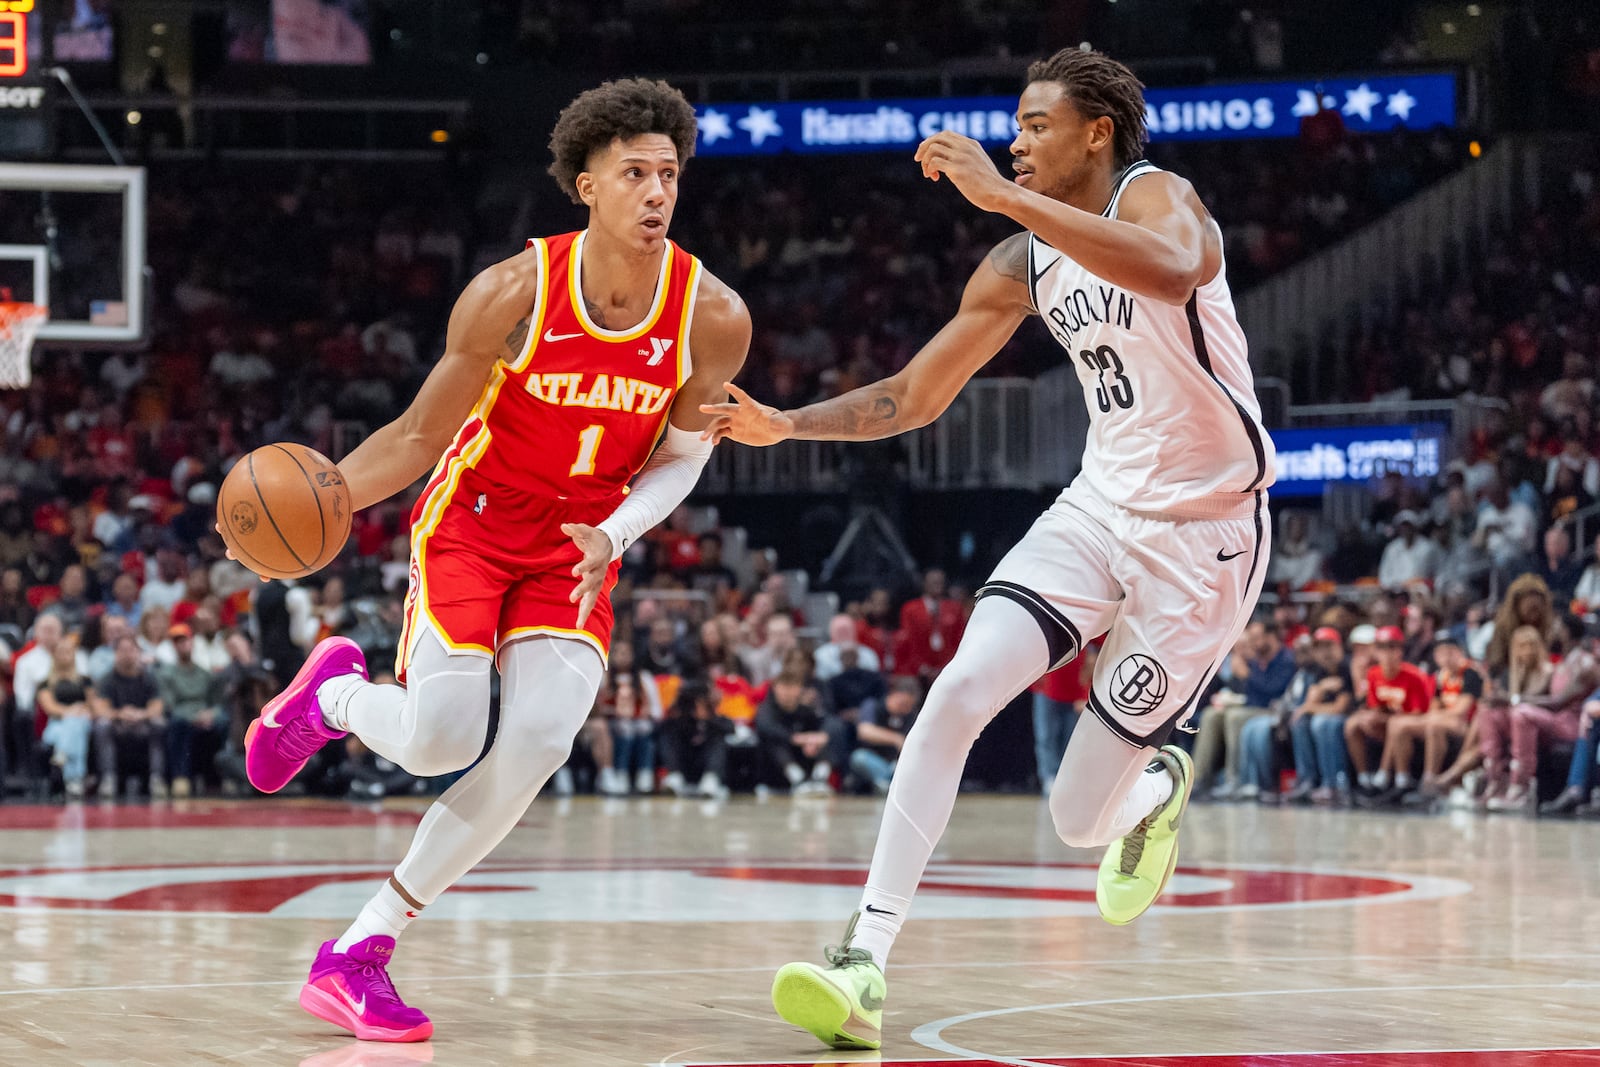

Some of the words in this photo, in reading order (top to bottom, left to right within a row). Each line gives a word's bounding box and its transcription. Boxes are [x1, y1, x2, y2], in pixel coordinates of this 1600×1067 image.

[1049, 284, 1134, 350] BROOLYN
[1079, 344, 1135, 413] 33
[568, 424, 606, 478] 1
